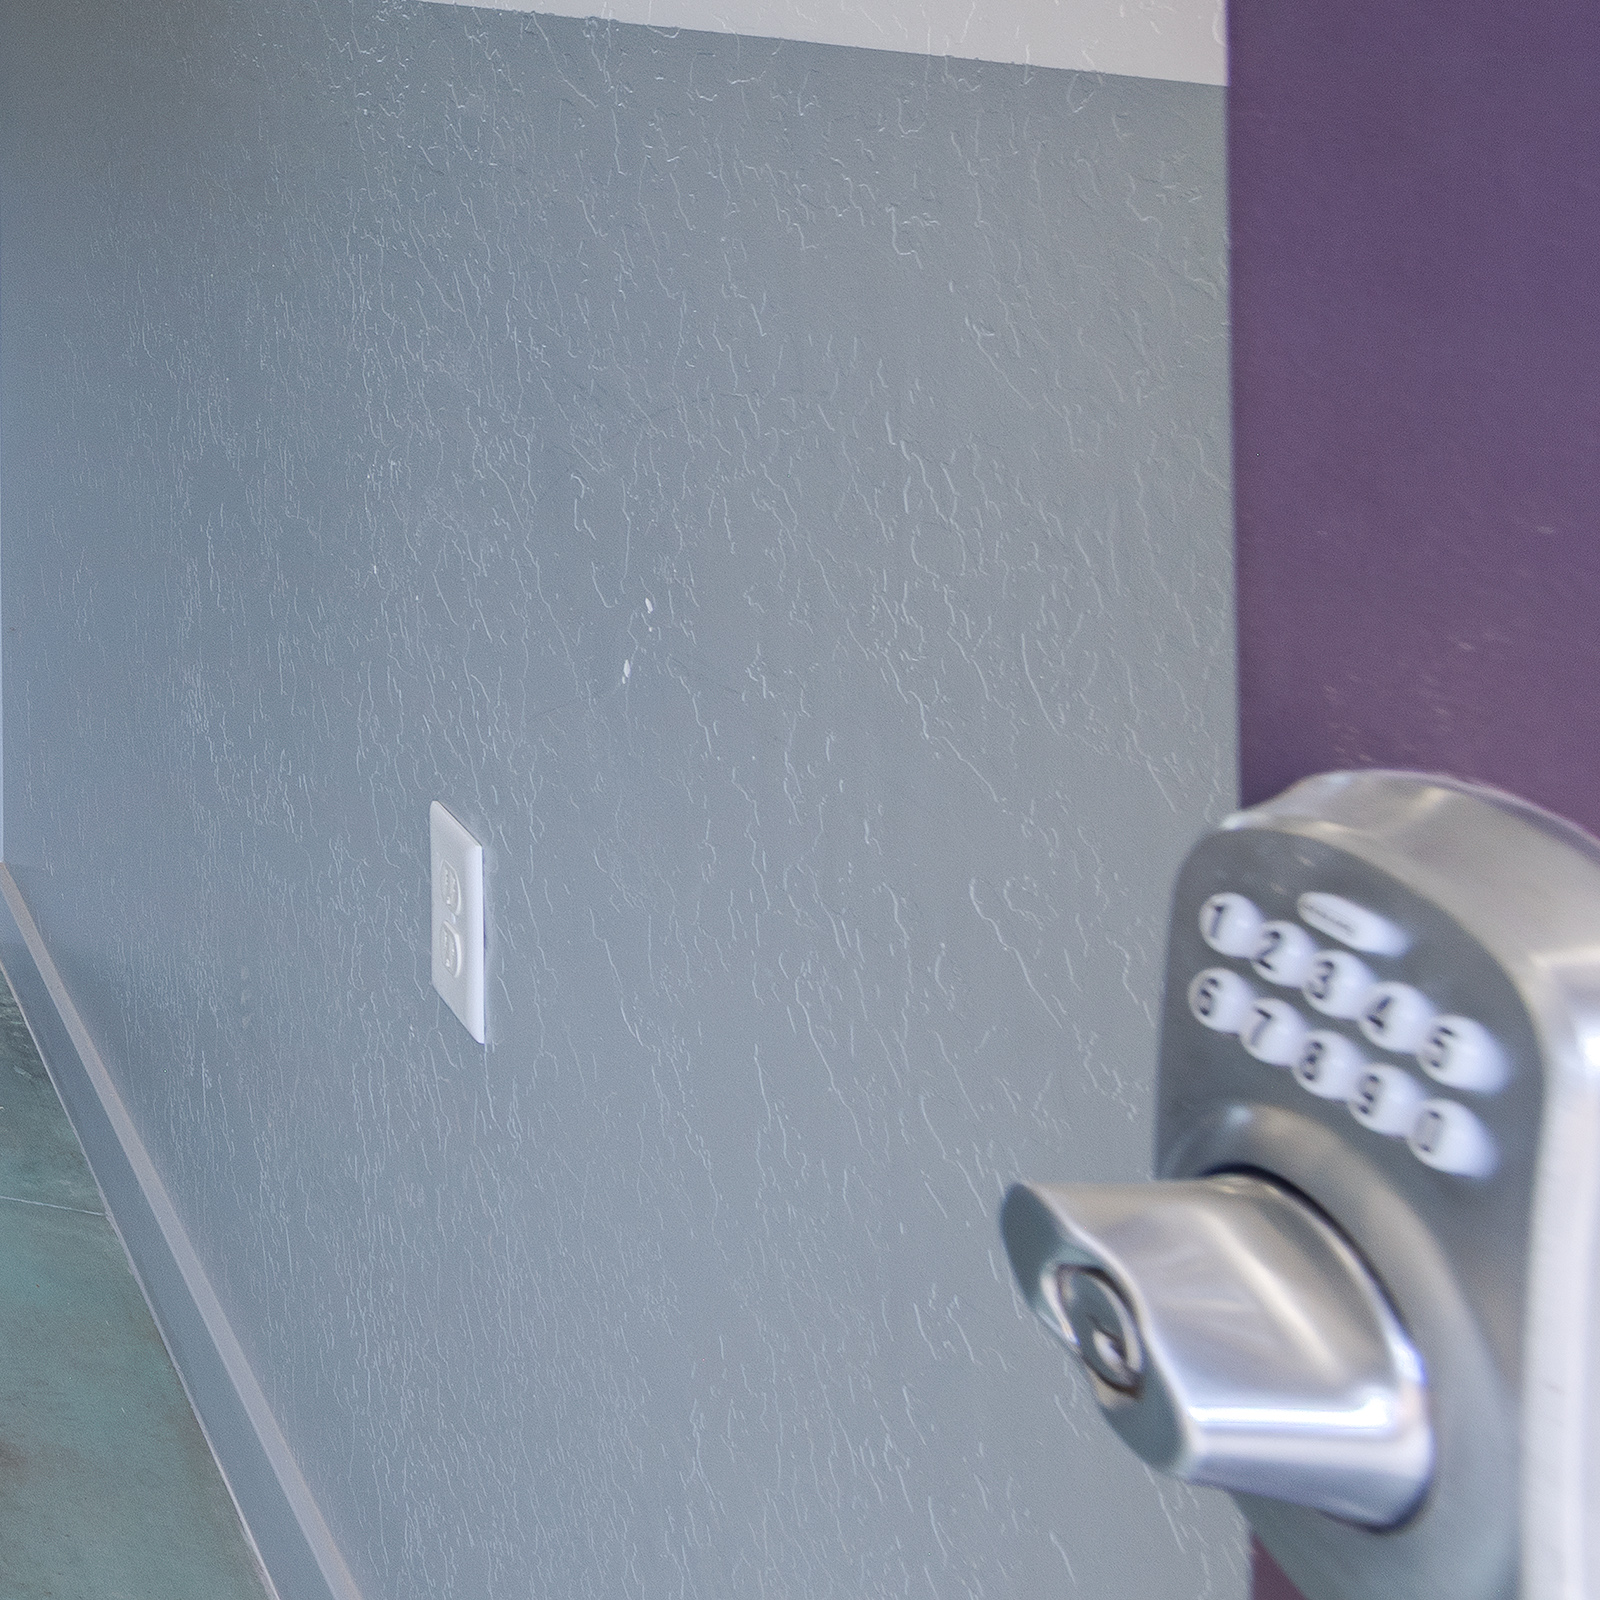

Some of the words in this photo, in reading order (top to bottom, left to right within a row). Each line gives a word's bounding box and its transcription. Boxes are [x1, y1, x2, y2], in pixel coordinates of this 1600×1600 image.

[1199, 976, 1221, 1017] 6
[1251, 1007, 1273, 1046] 7
[1302, 1040, 1324, 1082] 8
[1358, 1074, 1380, 1115] 9
[1209, 903, 1226, 939] 1
[1257, 930, 1282, 971] 2
[1310, 959, 1336, 1000] 3
[1366, 995, 1394, 1032] 4
[1426, 1025, 1455, 1068] 5
